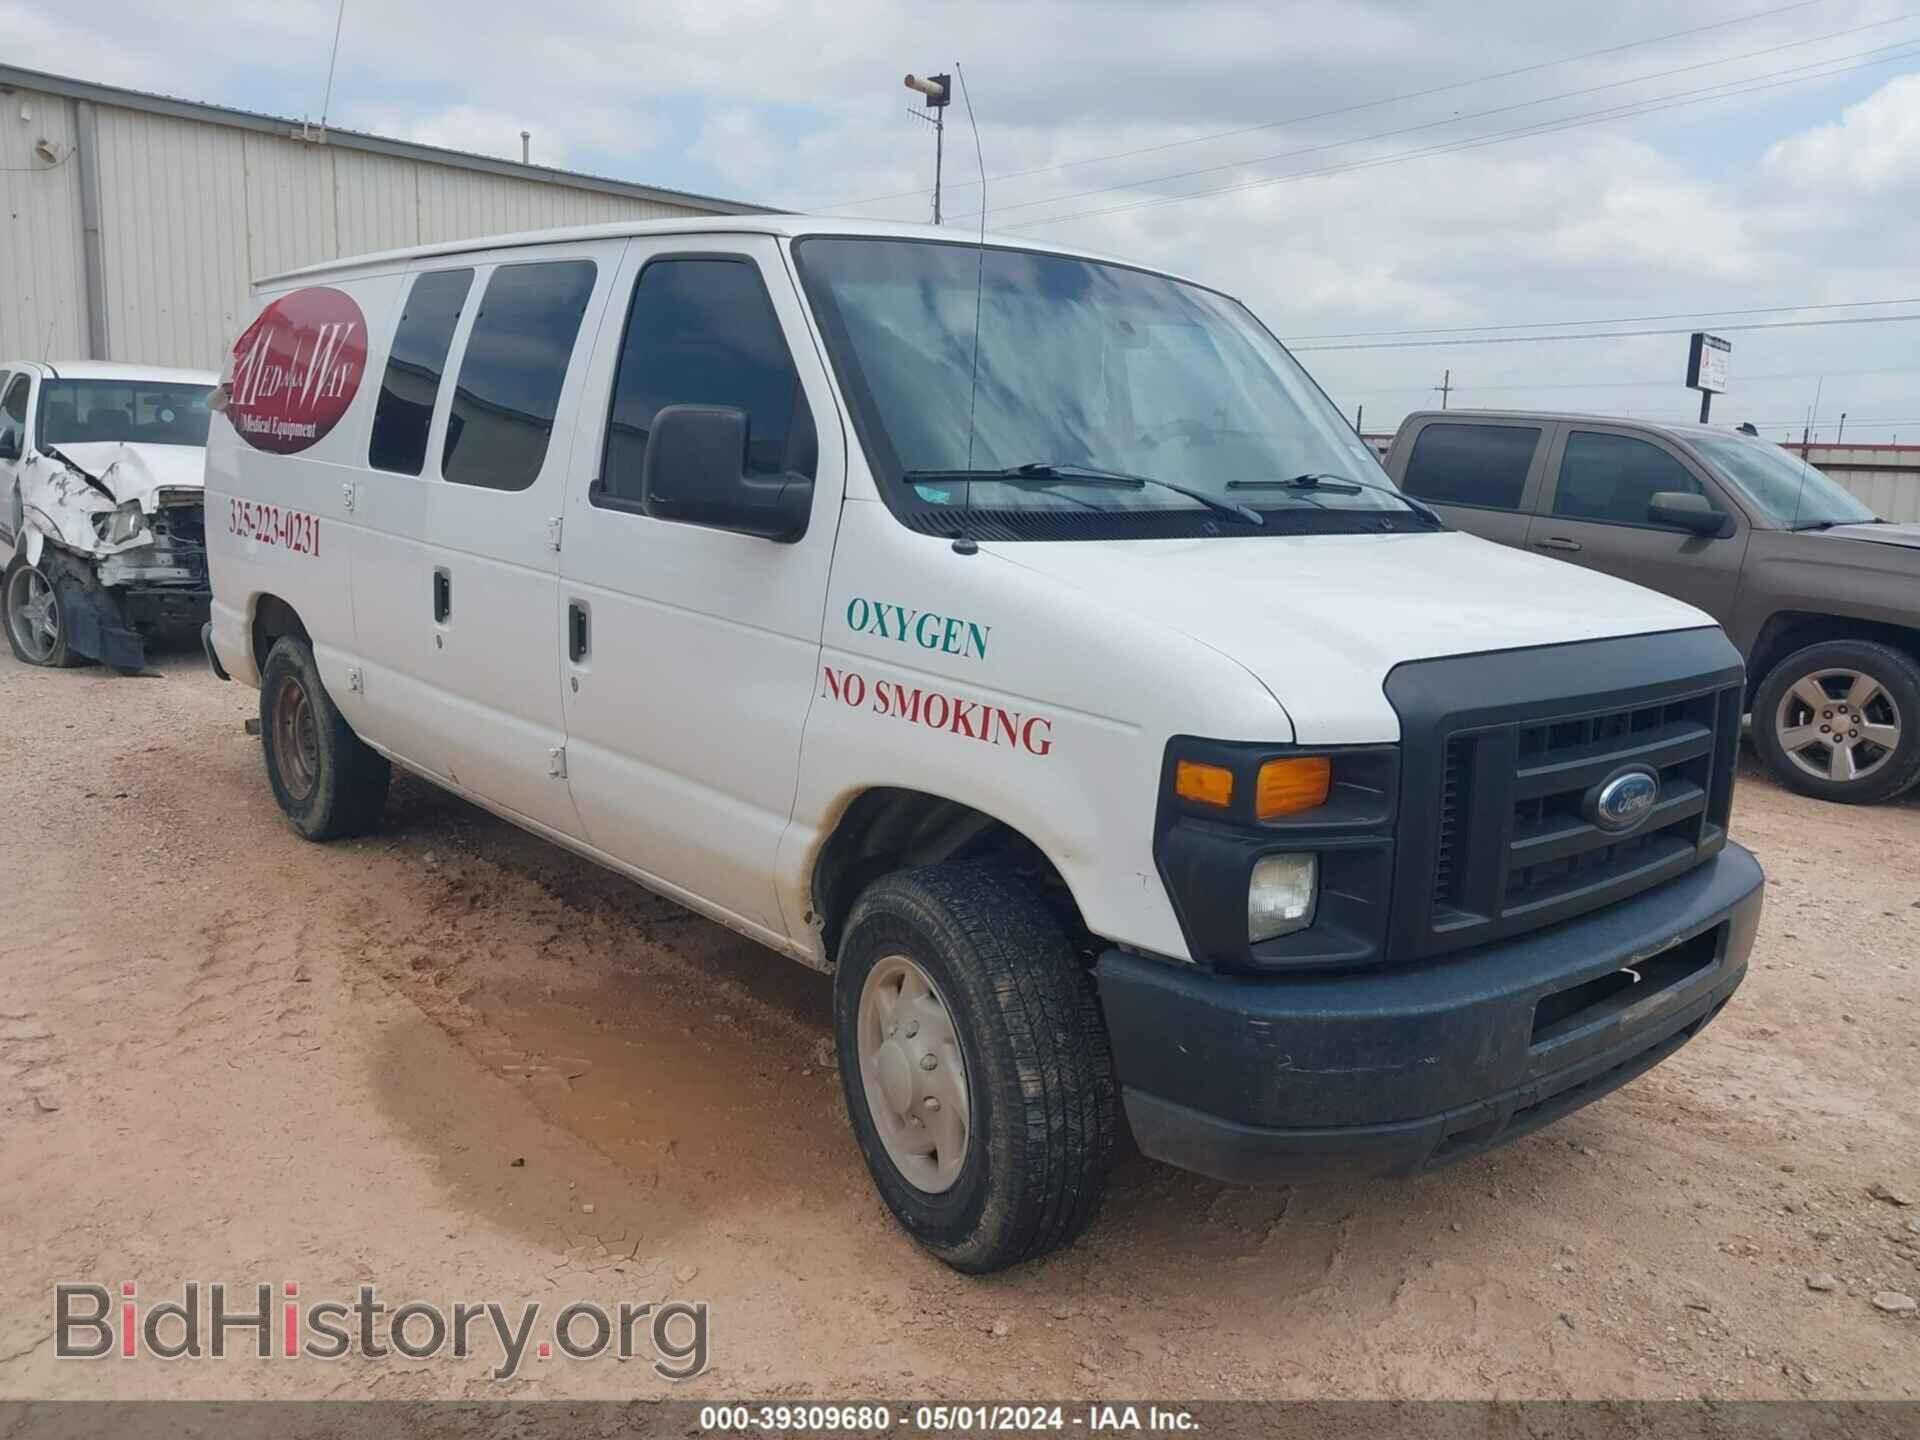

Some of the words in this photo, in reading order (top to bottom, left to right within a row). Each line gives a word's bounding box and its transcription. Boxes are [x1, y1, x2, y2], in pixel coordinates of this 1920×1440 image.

[272, 416, 316, 441] Equipment
[229, 498, 320, 557] 325-223-0231
[847, 597, 992, 660] OXYGEN
[821, 666, 866, 707] NO
[873, 680, 1053, 756] SMOKING
[1617, 790, 1654, 813] Ford
